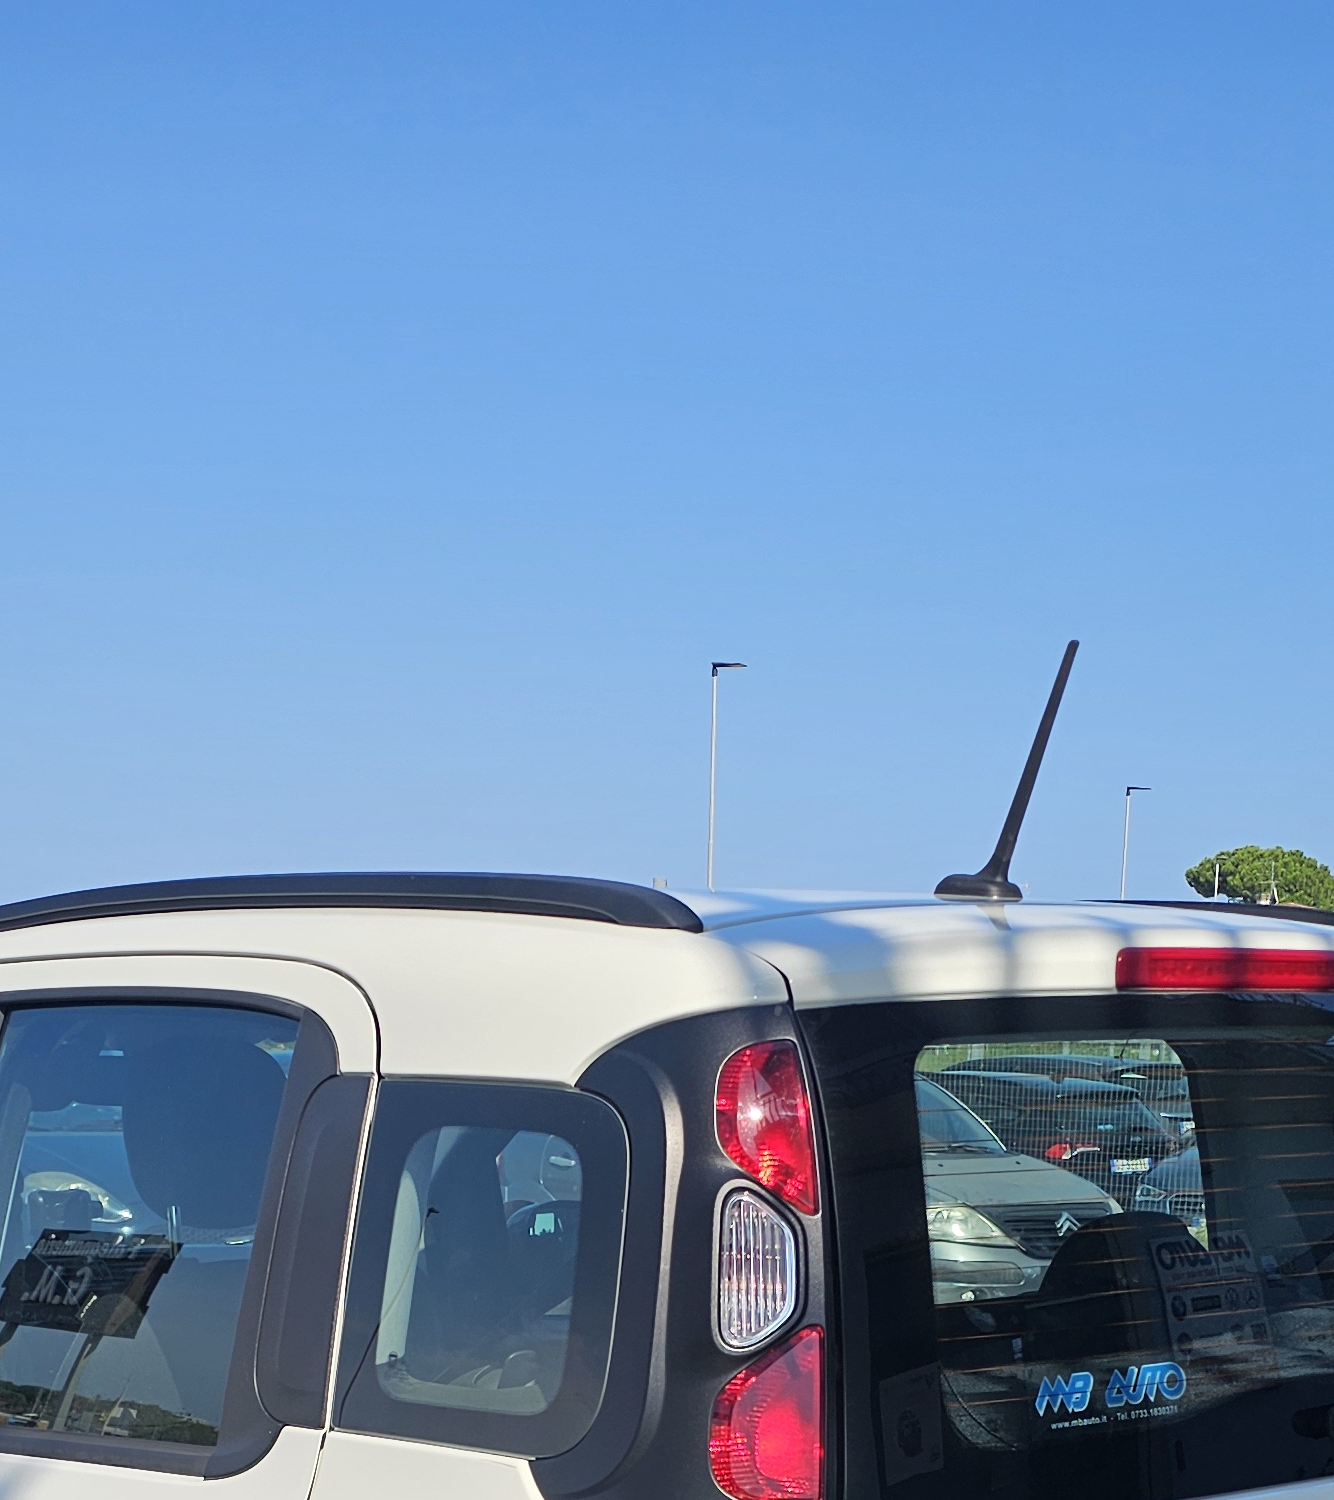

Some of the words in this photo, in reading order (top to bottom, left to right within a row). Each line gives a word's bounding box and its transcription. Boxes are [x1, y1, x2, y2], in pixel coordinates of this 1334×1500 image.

[1035, 1371, 1094, 1417] MB
[1105, 1361, 1187, 1408] AUTO
[1051, 1415, 1108, 1430] www.mbauto.it
[1116, 1411, 1130, 1421] Tel.
